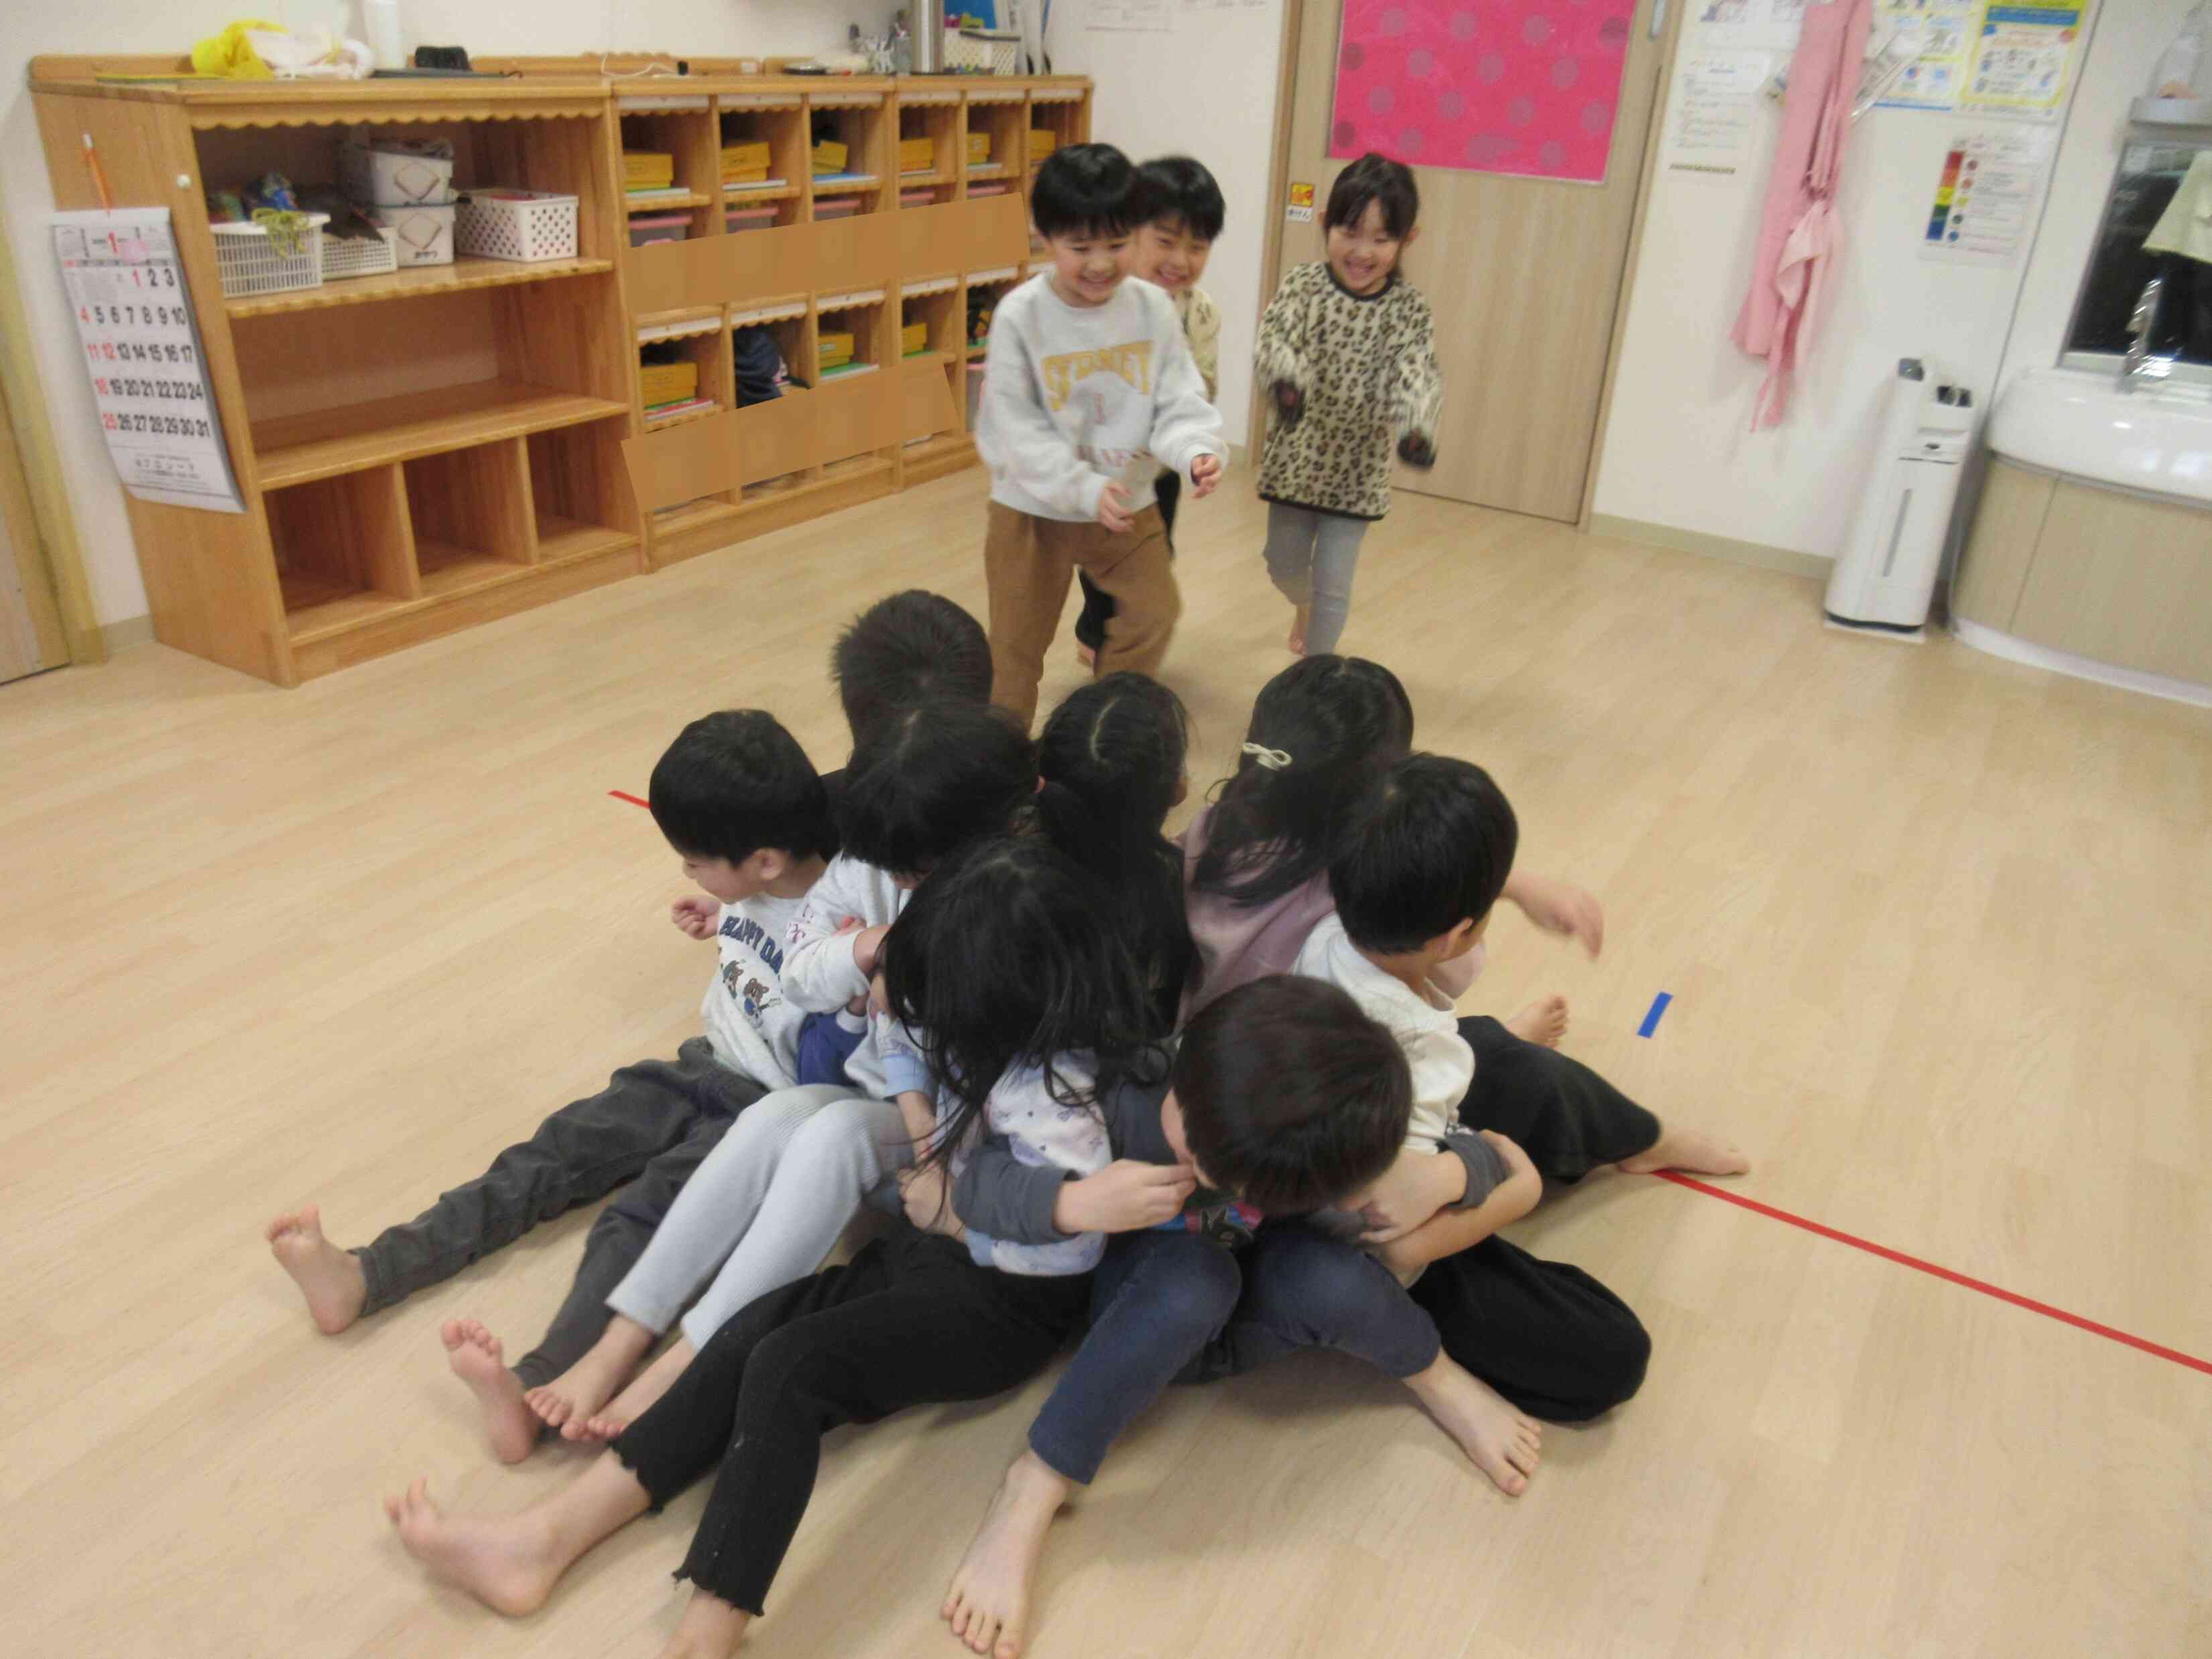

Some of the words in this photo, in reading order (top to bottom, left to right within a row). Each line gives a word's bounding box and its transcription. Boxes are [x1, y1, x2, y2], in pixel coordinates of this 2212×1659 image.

[131, 268, 142, 288] 1
[147, 268, 158, 287] 2
[164, 267, 174, 287] 3
[95, 306, 105, 324] 5
[111, 306, 120, 324] 6
[125, 306, 134, 324] 7
[142, 306, 152, 324] 8
[158, 306, 168, 325] 9
[172, 306, 186, 326] 10
[103, 343, 118, 360] 12
[117, 343, 131, 360] 13
[132, 343, 146, 361] 14
[148, 344, 162, 362] 15
[164, 344, 178, 362] 16
[180, 345, 192, 363] 17
[110, 378, 123, 396] 19
[124, 378, 139, 396] 20
[141, 379, 154, 397] 21
[156, 380, 172, 398] 22
[172, 381, 188, 400] 23
[187, 381, 204, 400] 24
[117, 413, 133, 431] 26
[134, 414, 147, 432] 27
[149, 415, 164, 433] 28
[164, 416, 179, 434] 29
[180, 418, 195, 436] 30
[195, 419, 211, 437] 31
[760, 936, 784, 974] DA
